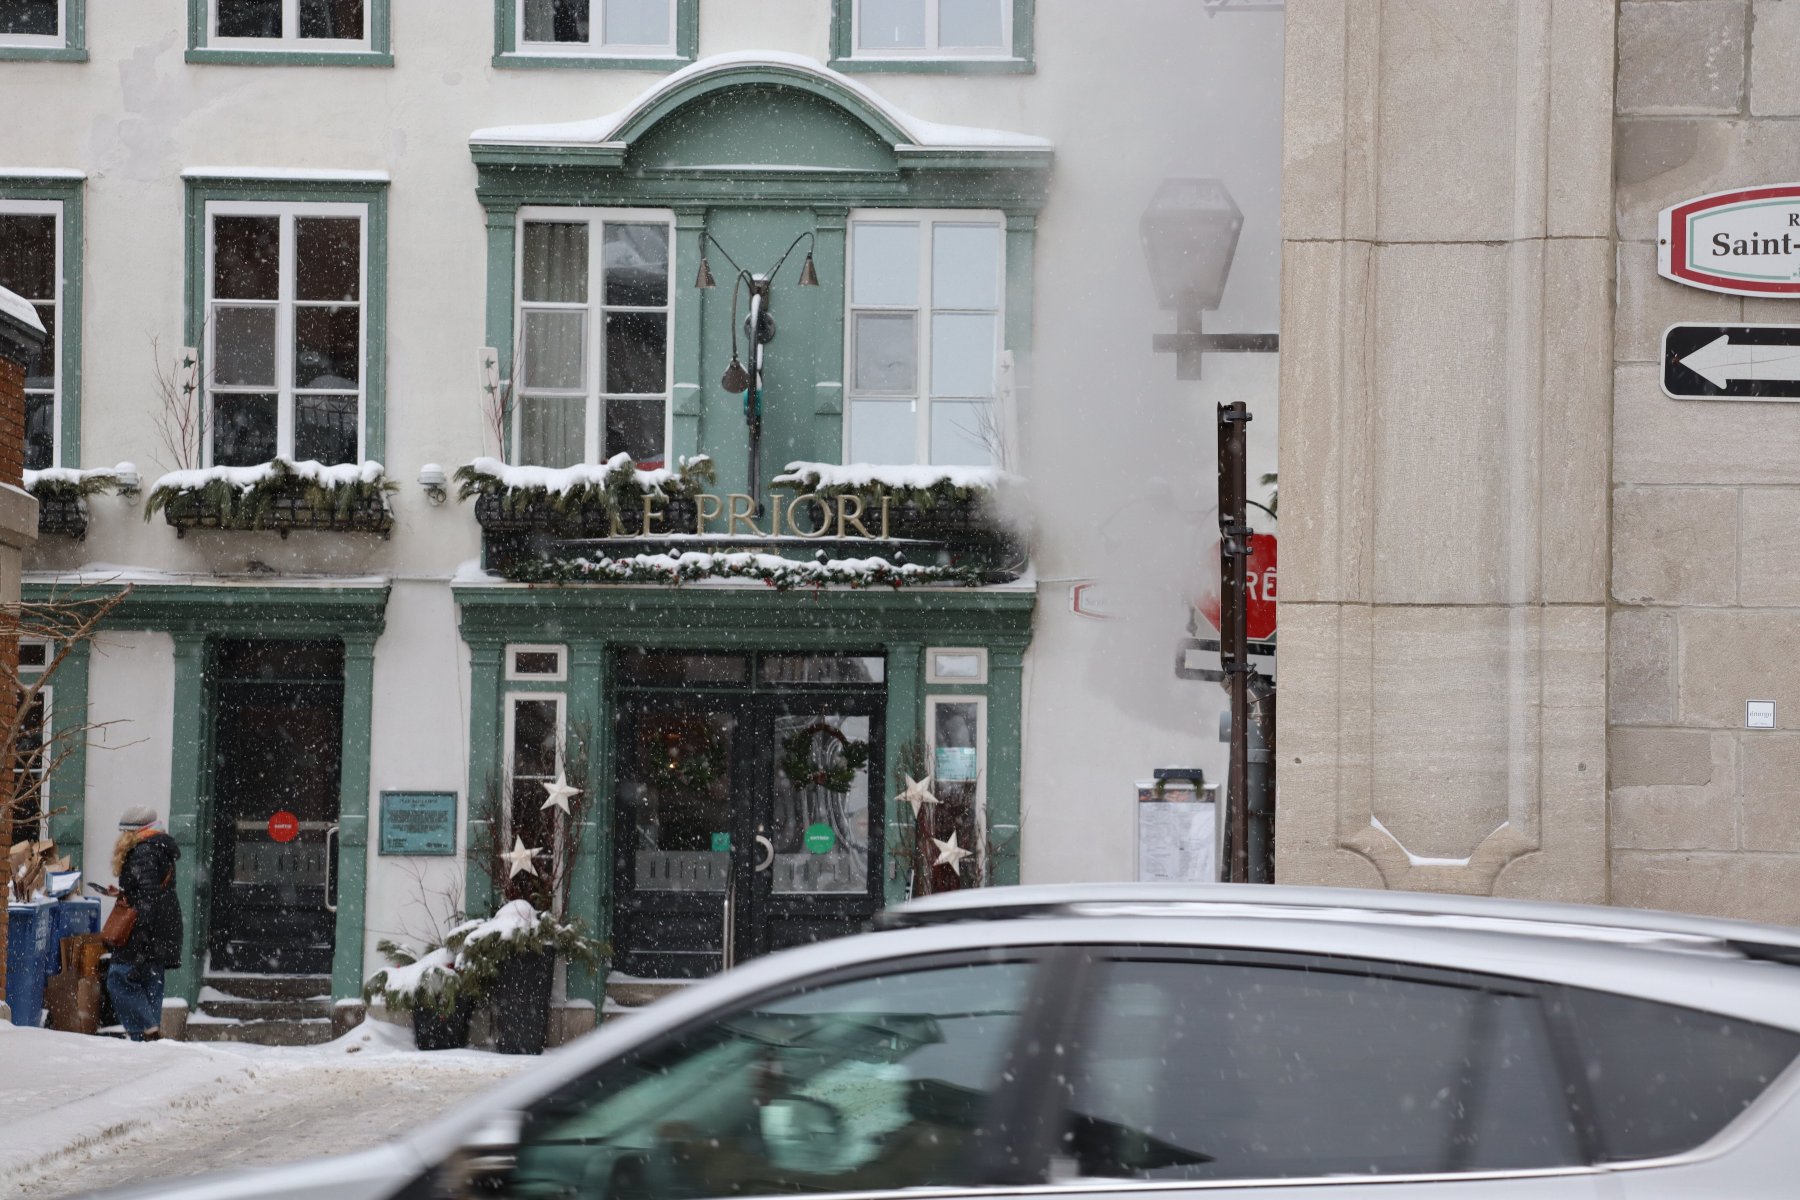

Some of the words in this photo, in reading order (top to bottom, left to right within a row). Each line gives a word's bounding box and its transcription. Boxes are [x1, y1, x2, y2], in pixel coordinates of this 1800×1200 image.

[1788, 213, 1800, 227] R
[1712, 231, 1800, 256] Saint-
[694, 493, 892, 540] PRIORI
